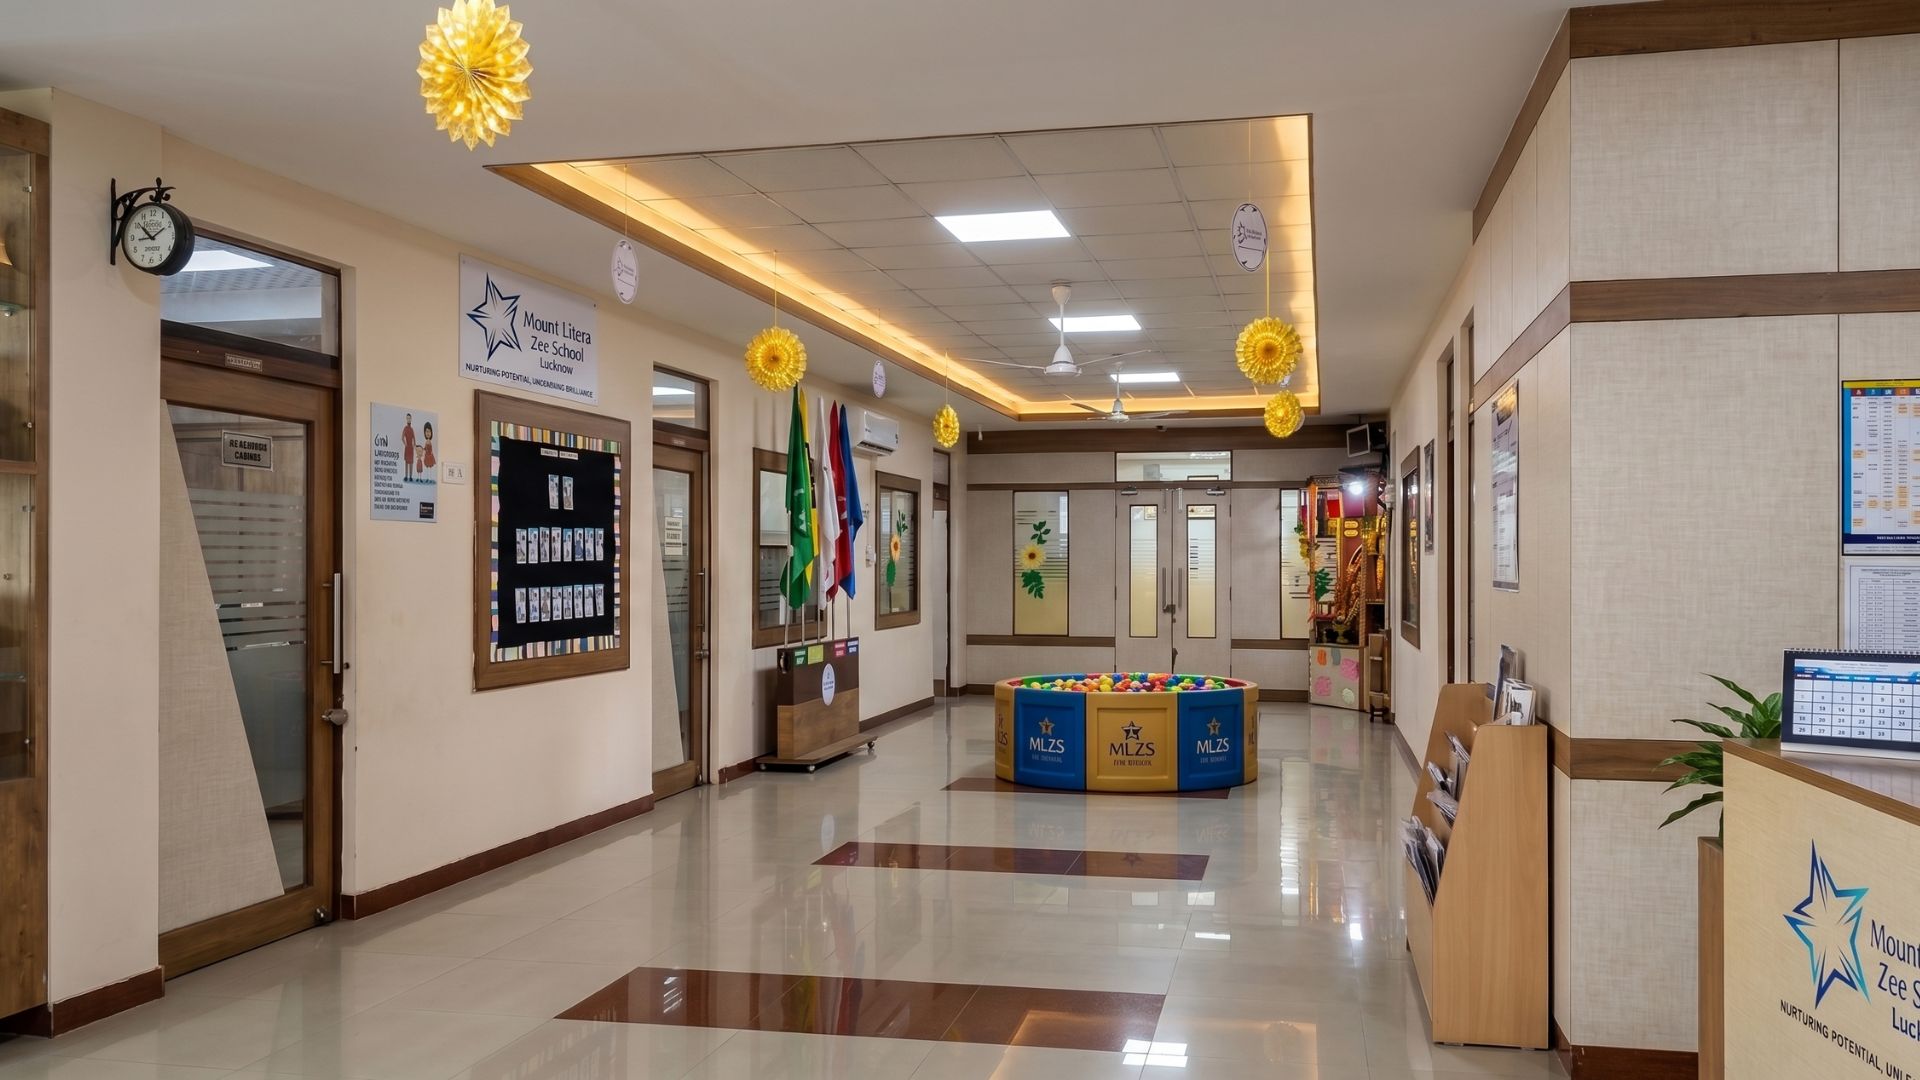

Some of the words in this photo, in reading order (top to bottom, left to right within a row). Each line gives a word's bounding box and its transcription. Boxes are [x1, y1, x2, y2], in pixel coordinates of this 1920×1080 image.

[523, 310, 559, 336] Mount
[562, 321, 592, 344] Litera
[530, 336, 549, 353] Zee
[552, 340, 584, 362] School
[465, 362, 500, 378] NURTURING
[540, 357, 574, 375] Lucknow
[1029, 737, 1065, 754] MLZS
[1110, 742, 1156, 756] MLZS
[1196, 738, 1230, 754] MLZS
[1878, 962, 1907, 1001] Zee
[1780, 999, 1829, 1039] NURTURING
[1832, 1030, 1884, 1074] POTENTIAL,
